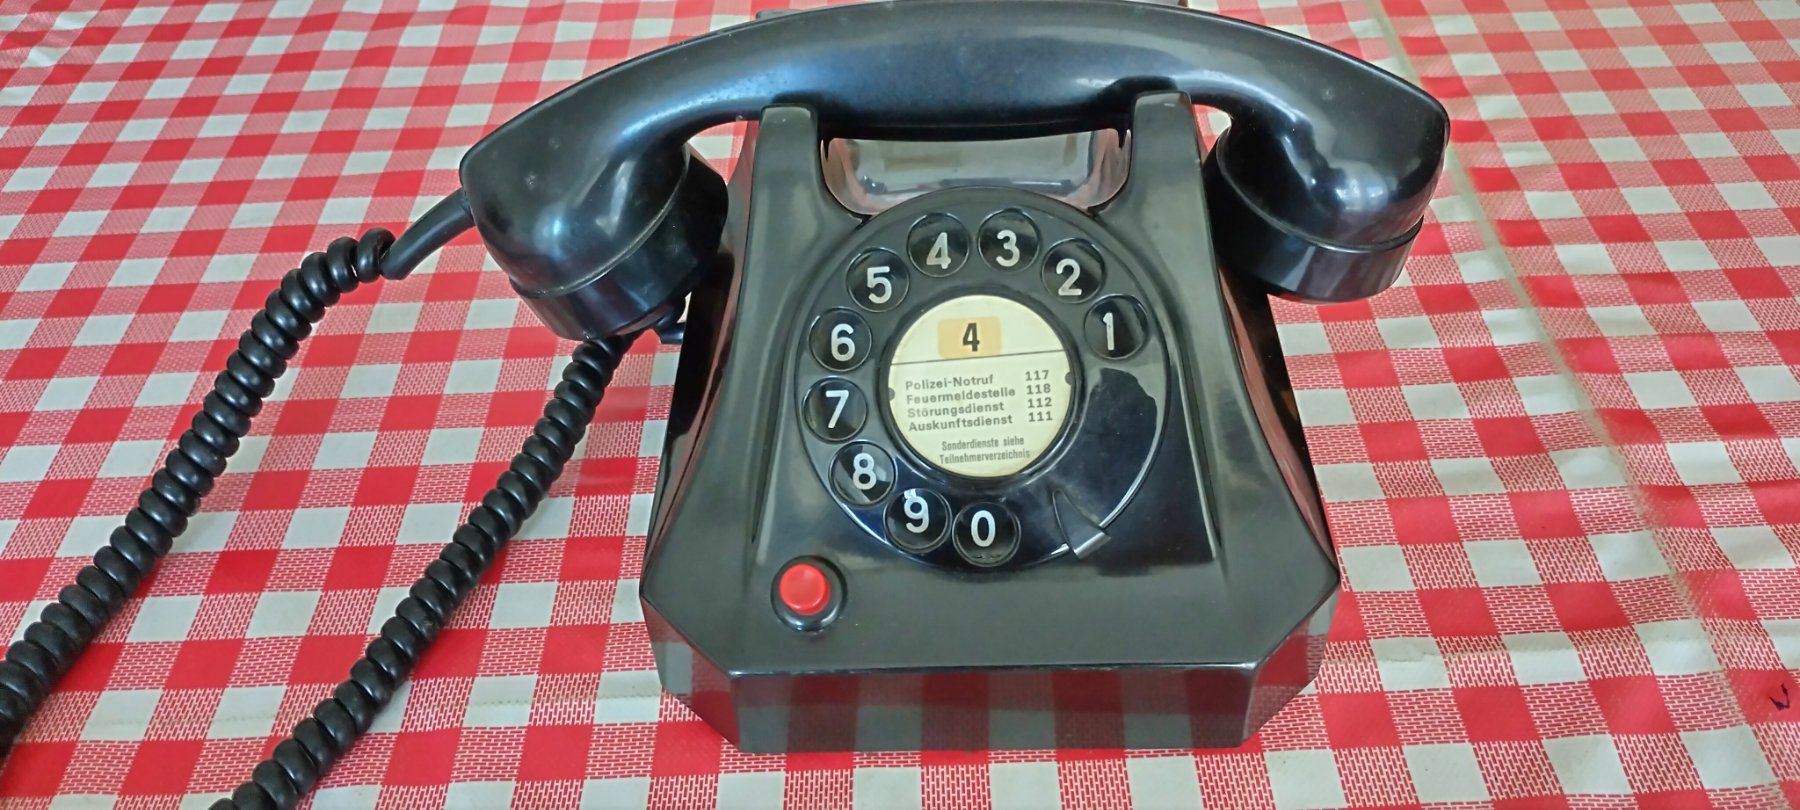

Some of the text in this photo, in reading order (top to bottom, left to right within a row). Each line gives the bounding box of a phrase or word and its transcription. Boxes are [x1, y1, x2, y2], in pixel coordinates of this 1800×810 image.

[926, 232, 951, 269] 4
[996, 229, 1020, 267] 3
[866, 266, 892, 304] 5
[1056, 258, 1082, 296] 2
[830, 323, 855, 362] 6
[962, 322, 980, 352] 4
[1102, 312, 1114, 351] 1
[905, 370, 1050, 391] Polizei-Notruf 117
[907, 383, 1051, 405] Feuermeldestelle 118
[825, 390, 849, 429] 7
[907, 397, 1053, 418] Störungsdienst 112
[908, 411, 1053, 432] Auskunftsdienst 111
[939, 449, 1031, 465] Teilnehmerverzeichnis
[941, 435, 1024, 451] Sonderdienste siehe
[853, 452, 878, 490] 8
[904, 494, 929, 533] 9
[970, 510, 996, 547] 0
